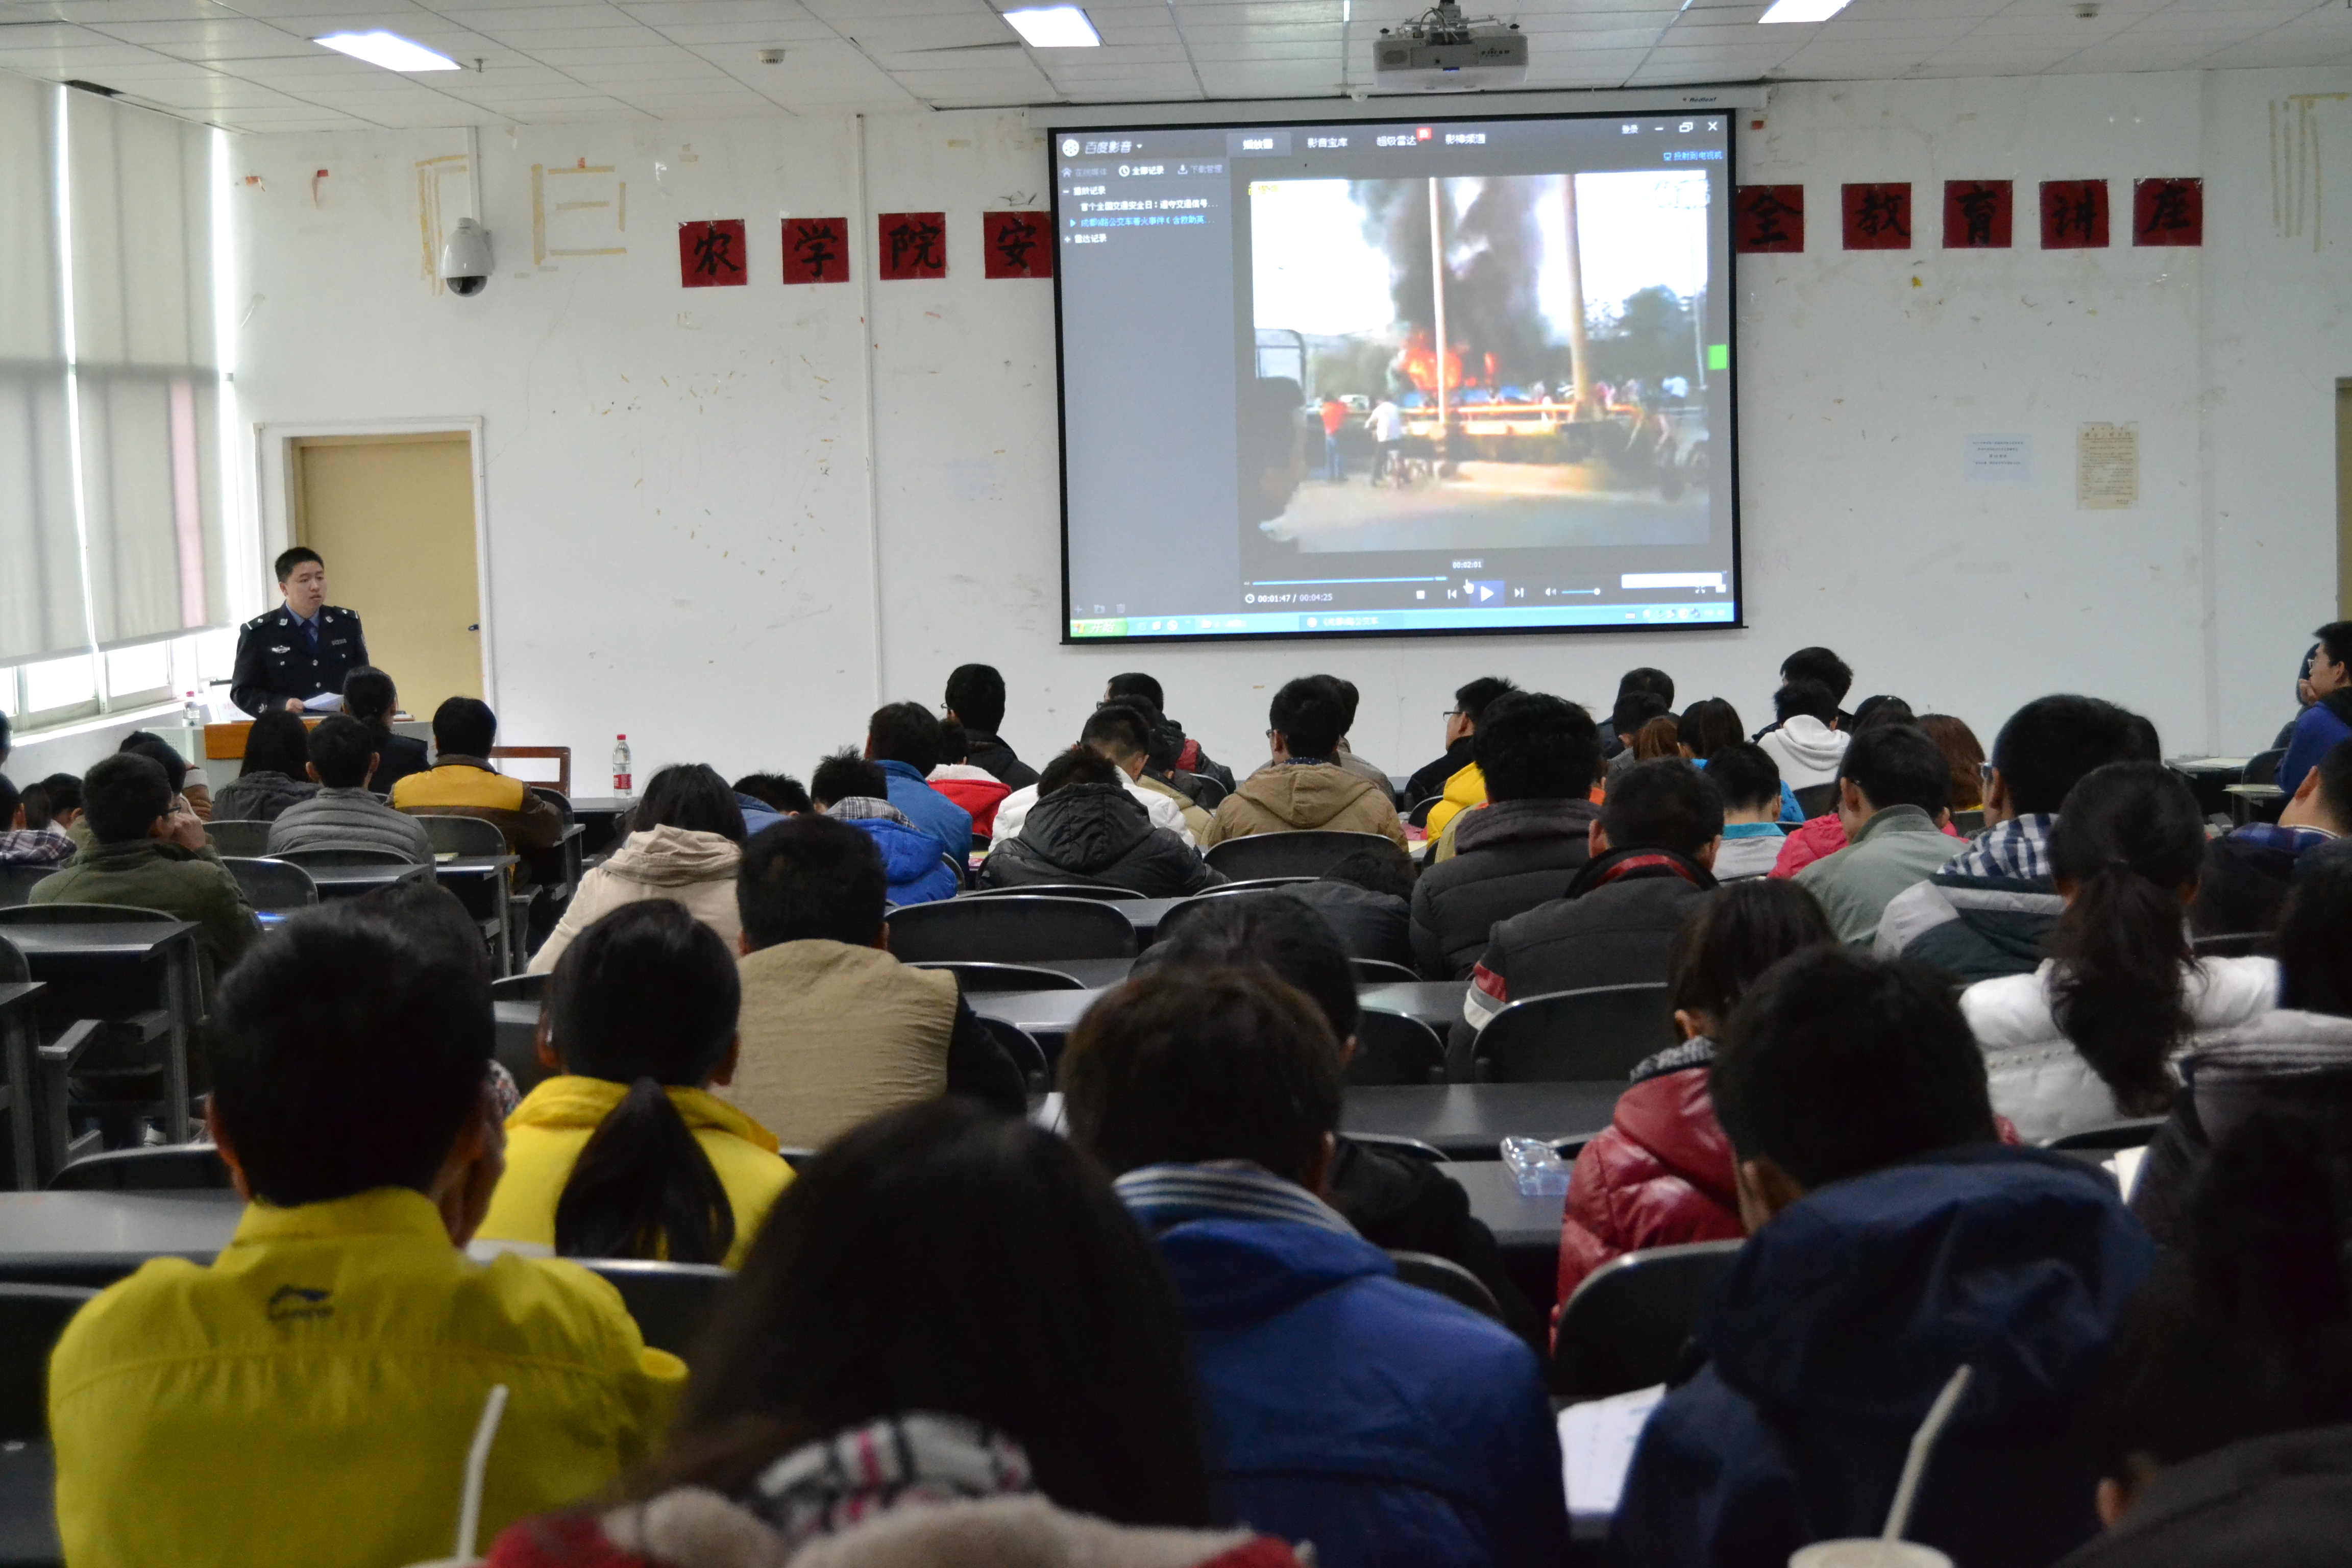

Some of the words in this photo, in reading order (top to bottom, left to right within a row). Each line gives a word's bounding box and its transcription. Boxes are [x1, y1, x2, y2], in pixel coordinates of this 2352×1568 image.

[1085, 140, 1132, 155] 百度影音
[1132, 165, 1164, 176] 全部记录
[1257, 595, 1291, 603] 00:01:47
[1299, 594, 1333, 602] 00:04:25
[1089, 621, 1115, 634] 开始
